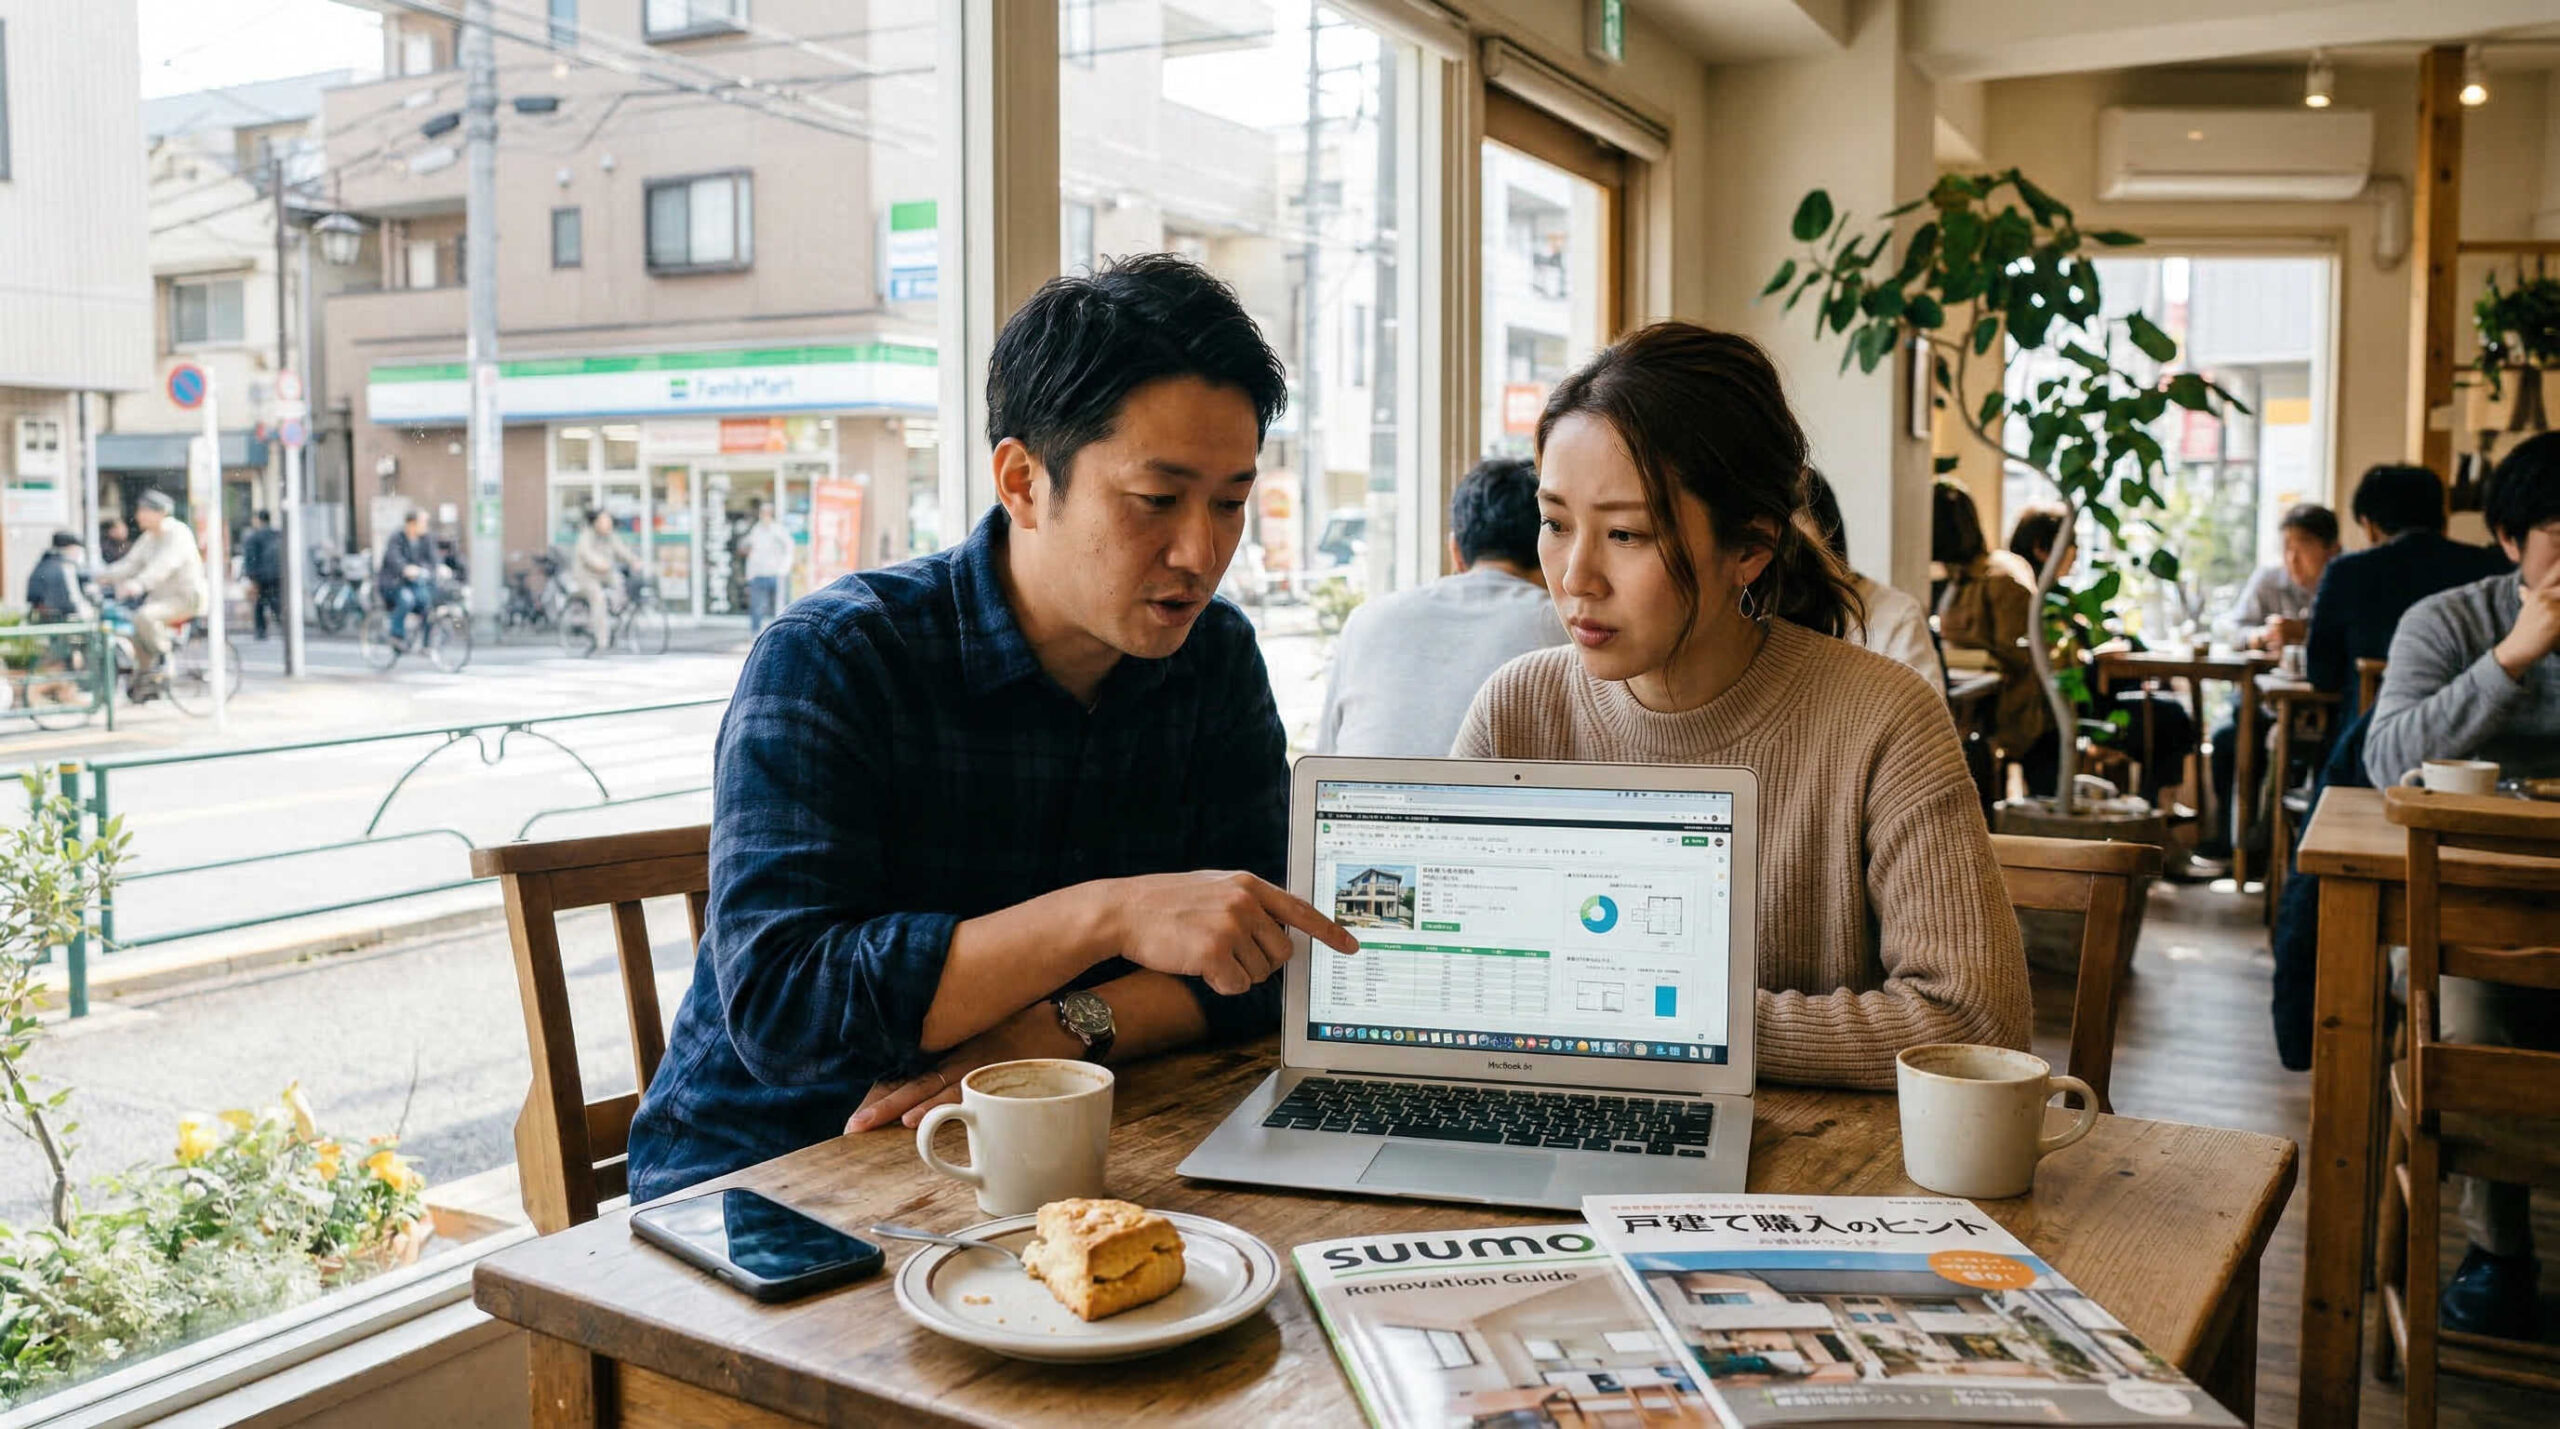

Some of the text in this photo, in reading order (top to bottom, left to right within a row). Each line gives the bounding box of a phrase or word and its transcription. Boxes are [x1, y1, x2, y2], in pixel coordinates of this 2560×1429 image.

[697, 374, 794, 399] FamilyMart
[1616, 1212, 1989, 1236] 戸建て購入のヒント
[1344, 1270, 1578, 1297] Renovation Guide
